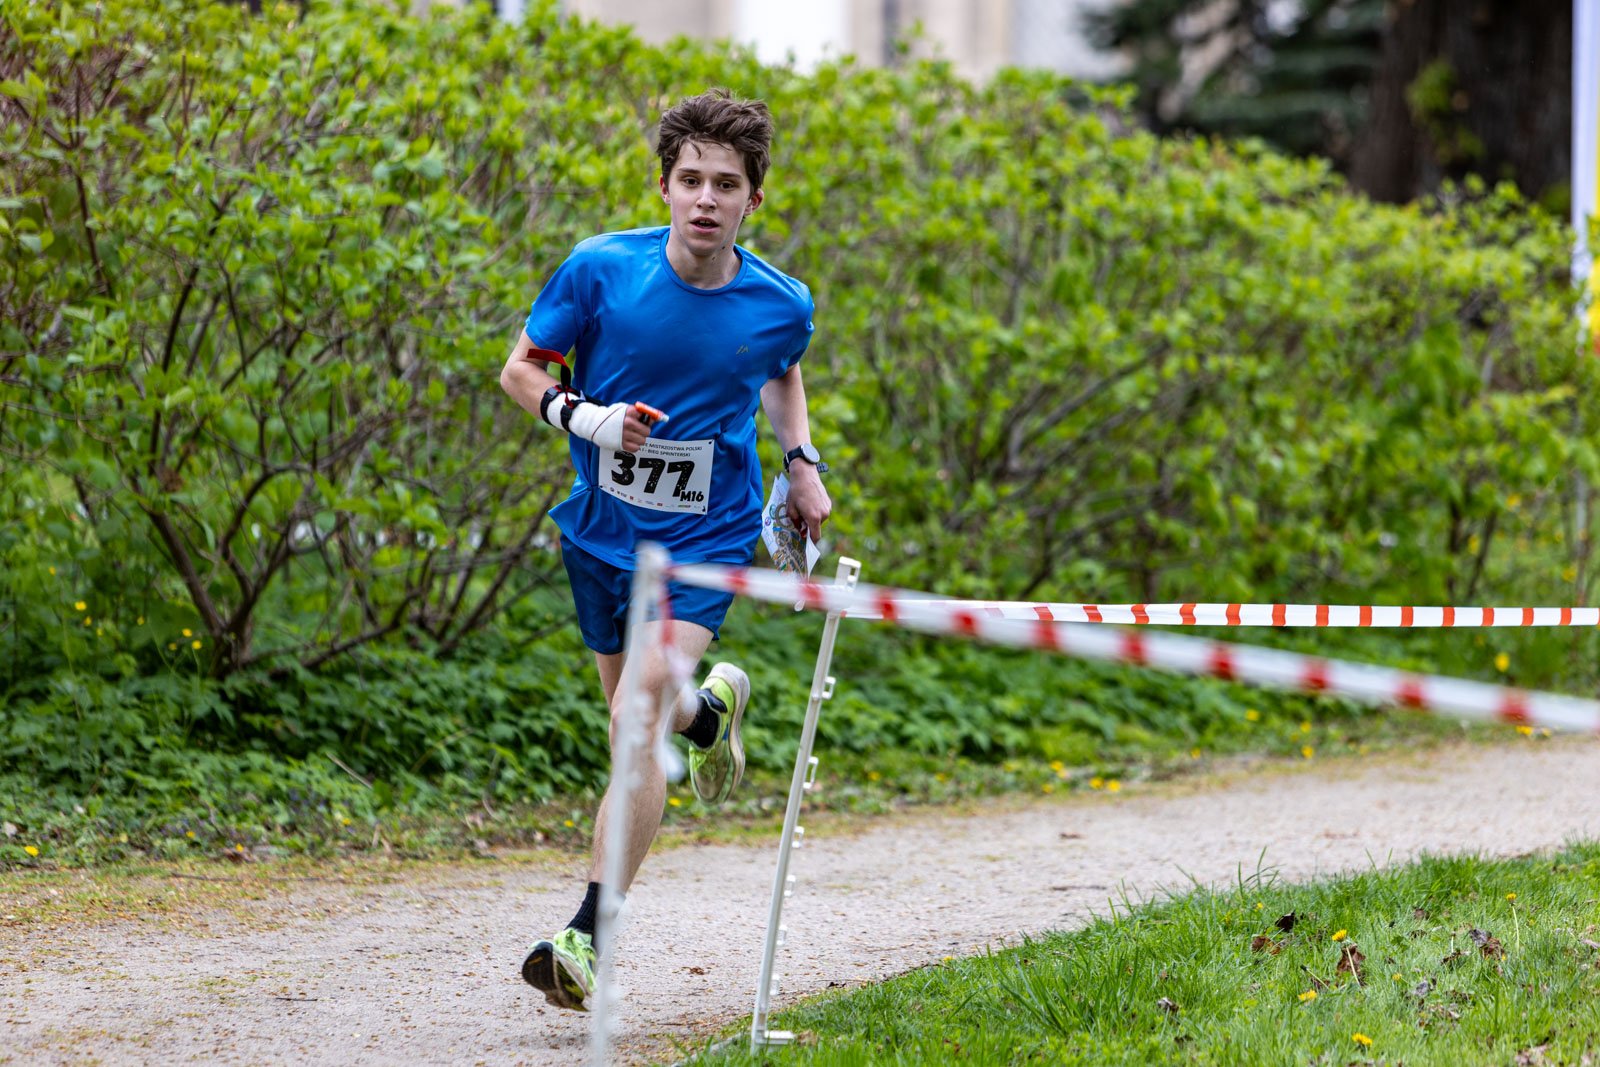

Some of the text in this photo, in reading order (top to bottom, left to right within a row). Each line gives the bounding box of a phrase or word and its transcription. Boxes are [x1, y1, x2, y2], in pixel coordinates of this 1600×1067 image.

[649, 443, 684, 451] MISTRZOSTWA
[611, 450, 695, 497] 377
[680, 490, 704, 502] M16
